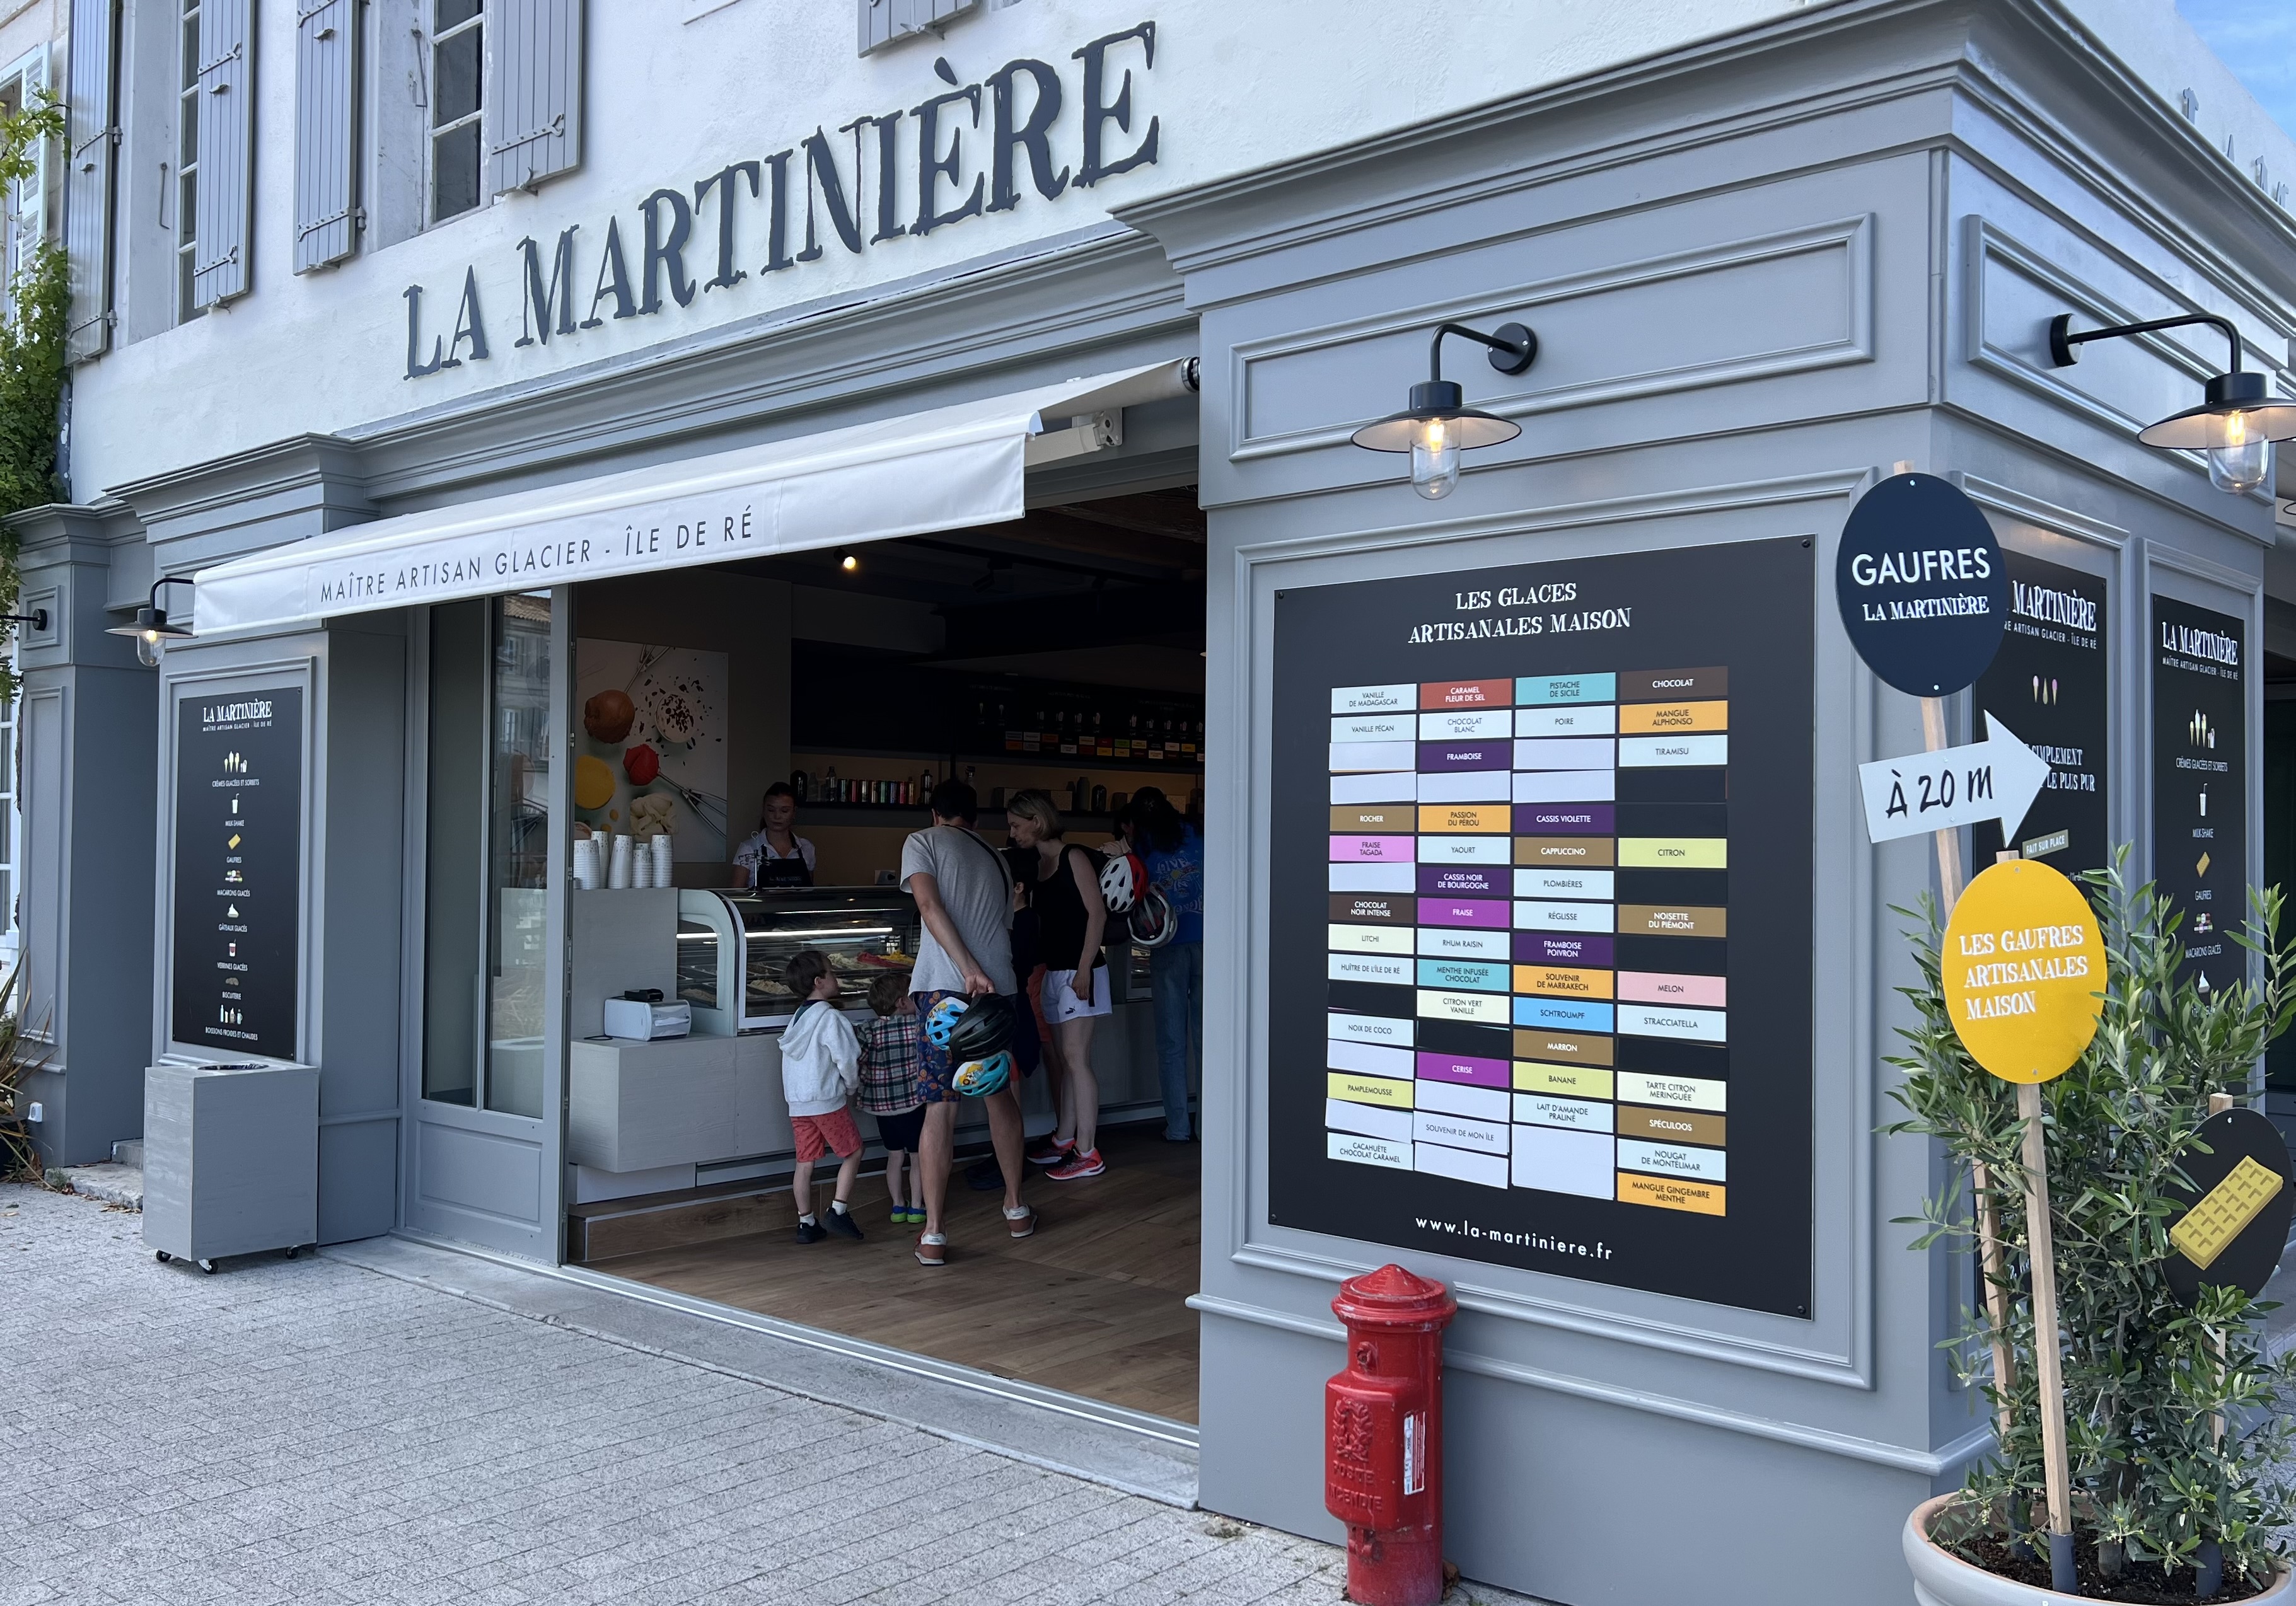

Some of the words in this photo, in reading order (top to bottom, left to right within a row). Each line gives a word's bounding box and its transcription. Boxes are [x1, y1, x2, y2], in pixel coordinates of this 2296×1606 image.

[403, 264, 489, 381] LA
[514, 20, 1159, 348] MARTINIÈRE
[321, 572, 384, 603] MAÎTRE
[395, 557, 480, 591] ARTISAN
[495, 540, 590, 575] GLACIER
[625, 525, 659, 556] ÎLE
[677, 521, 706, 549] DE
[724, 505, 751, 541] RÉ
[1852, 548, 1991, 586] GAUFRES
[1456, 591, 1491, 609] LES
[1498, 582, 1577, 607] GLACES
[1862, 602, 1887, 621] LA
[1889, 593, 1989, 620] MARTINIÈRE
[2012, 580, 2096, 632] MARTINIÈRE
[1408, 616, 1542, 644] ARTISANALES
[1550, 608, 1632, 633] MAISON
[2014, 624, 2039, 637] ARTISAN
[2041, 628, 2066, 642] GLACIER
[2071, 632, 2079, 646] ÎLE
[2082, 637, 2088, 647] DE
[2090, 637, 2097, 649] RÉ
[2162, 621, 2177, 652] LA
[2179, 625, 2238, 665] MARTINIÈRE
[1652, 679, 1693, 688] CHOCOLAT
[204, 707, 214, 722] LA
[217, 698, 272, 722] MARTINIÈRE
[1656, 709, 1689, 717] MANGUE
[1652, 718, 1692, 726] ALPHONSO
[2047, 772, 2057, 789] LE
[2060, 772, 2078, 791] PLUS
[2081, 773, 2095, 792] PUR
[1886, 769, 1908, 819] À
[1918, 770, 1955, 813] 20
[1461, 818, 1479, 826] PÉROU
[2026, 843, 2037, 855] FAIT
[2039, 840, 2048, 851] SUR
[2050, 835, 2065, 848] PLACE
[1543, 879, 1582, 887] PLOMBIÈRES
[1548, 911, 1577, 920] RÉGLISSE
[1661, 920, 1695, 929] PIÉMONT
[1544, 941, 1582, 949] FRAMBOISE
[1959, 933, 1995, 956] LES
[2001, 925, 2084, 952] GAUFRES
[1342, 964, 1360, 972] HUÎTRE
[1393, 966, 1400, 974] RÉ
[1464, 968, 1488, 976] INFUSÉE
[1964, 956, 2088, 988] ARTISANALES
[1445, 975, 1480, 983] CHOCOLAT
[1546, 973, 1579, 981] SOUVENIR
[1547, 982, 1588, 991] MARRAKECH
[1966, 991, 2036, 1020] MAISON
[1540, 1009, 1585, 1019] SCHTROUMPF
[1644, 1017, 1698, 1028] STRACCIATELLA
[1547, 1043, 1577, 1051] MARRON
[1452, 1065, 1473, 1073] CERISE
[1549, 1075, 1576, 1084] BANANE
[1348, 1085, 1392, 1095] PAMPLEMOUSSE
[1646, 1082, 1666, 1090] TARTE
[1668, 1084, 1695, 1092] CITRON
[1650, 1090, 1691, 1102] MERINGUÉE
[1552, 1105, 1588, 1115] D'AMANDE
[1550, 1112, 1575, 1122] PRALINÉ
[1650, 1119, 1692, 1131] SPÉCULOOS
[1426, 1124, 1456, 1135] SOUVENIR
[1468, 1130, 1484, 1139] MON
[1486, 1131, 1494, 1141] ÎLE
[1353, 1142, 1387, 1153] CACAHUÈTE
[1340, 1148, 1371, 1159] CHOCOLAT
[1373, 1152, 1400, 1163] CARAMEL
[1655, 1150, 1686, 1160] NOUGAT
[1653, 1158, 1700, 1171] MONTÉLIMAR
[1632, 1182, 1664, 1192] MANGUE
[1667, 1186, 1710, 1199] GINGEMBRE
[1656, 1194, 1685, 1204] MENTHE
[1416, 1218, 1612, 1260] www.la-martiniere.fr
[1333, 1460, 1374, 1484] POSTE
[1328, 1482, 1382, 1511] INCENDIE
